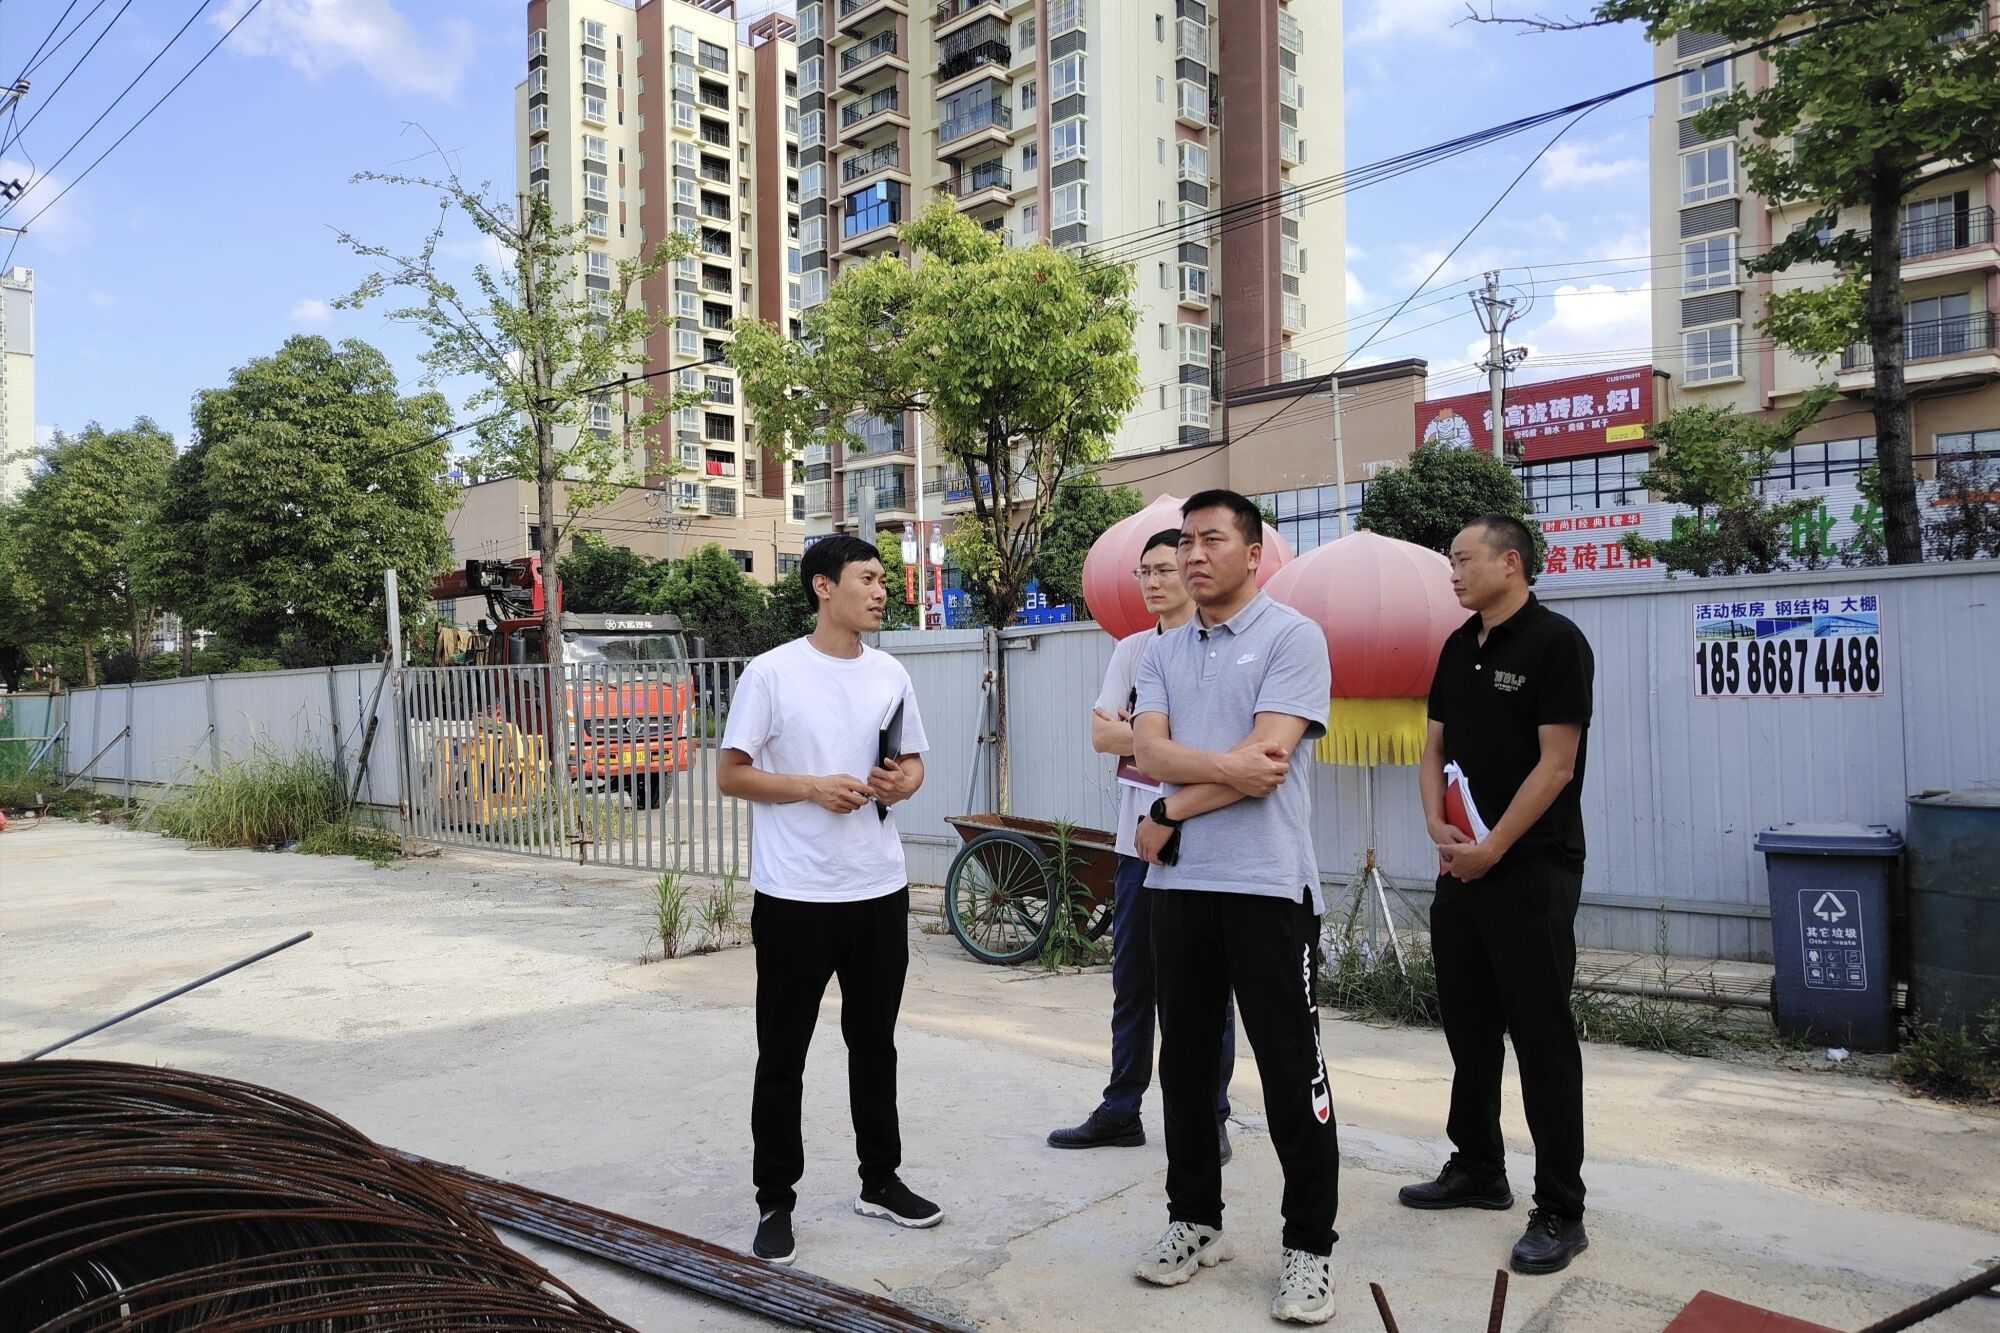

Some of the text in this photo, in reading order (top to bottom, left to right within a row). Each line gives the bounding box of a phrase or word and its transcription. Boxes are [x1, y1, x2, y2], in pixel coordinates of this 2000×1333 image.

[1696, 596, 1877, 620] 活动板房 钢结构 大棚
[1696, 636, 1880, 694] 185 8687 4488
[1806, 926, 1857, 938] 其它垃圾
